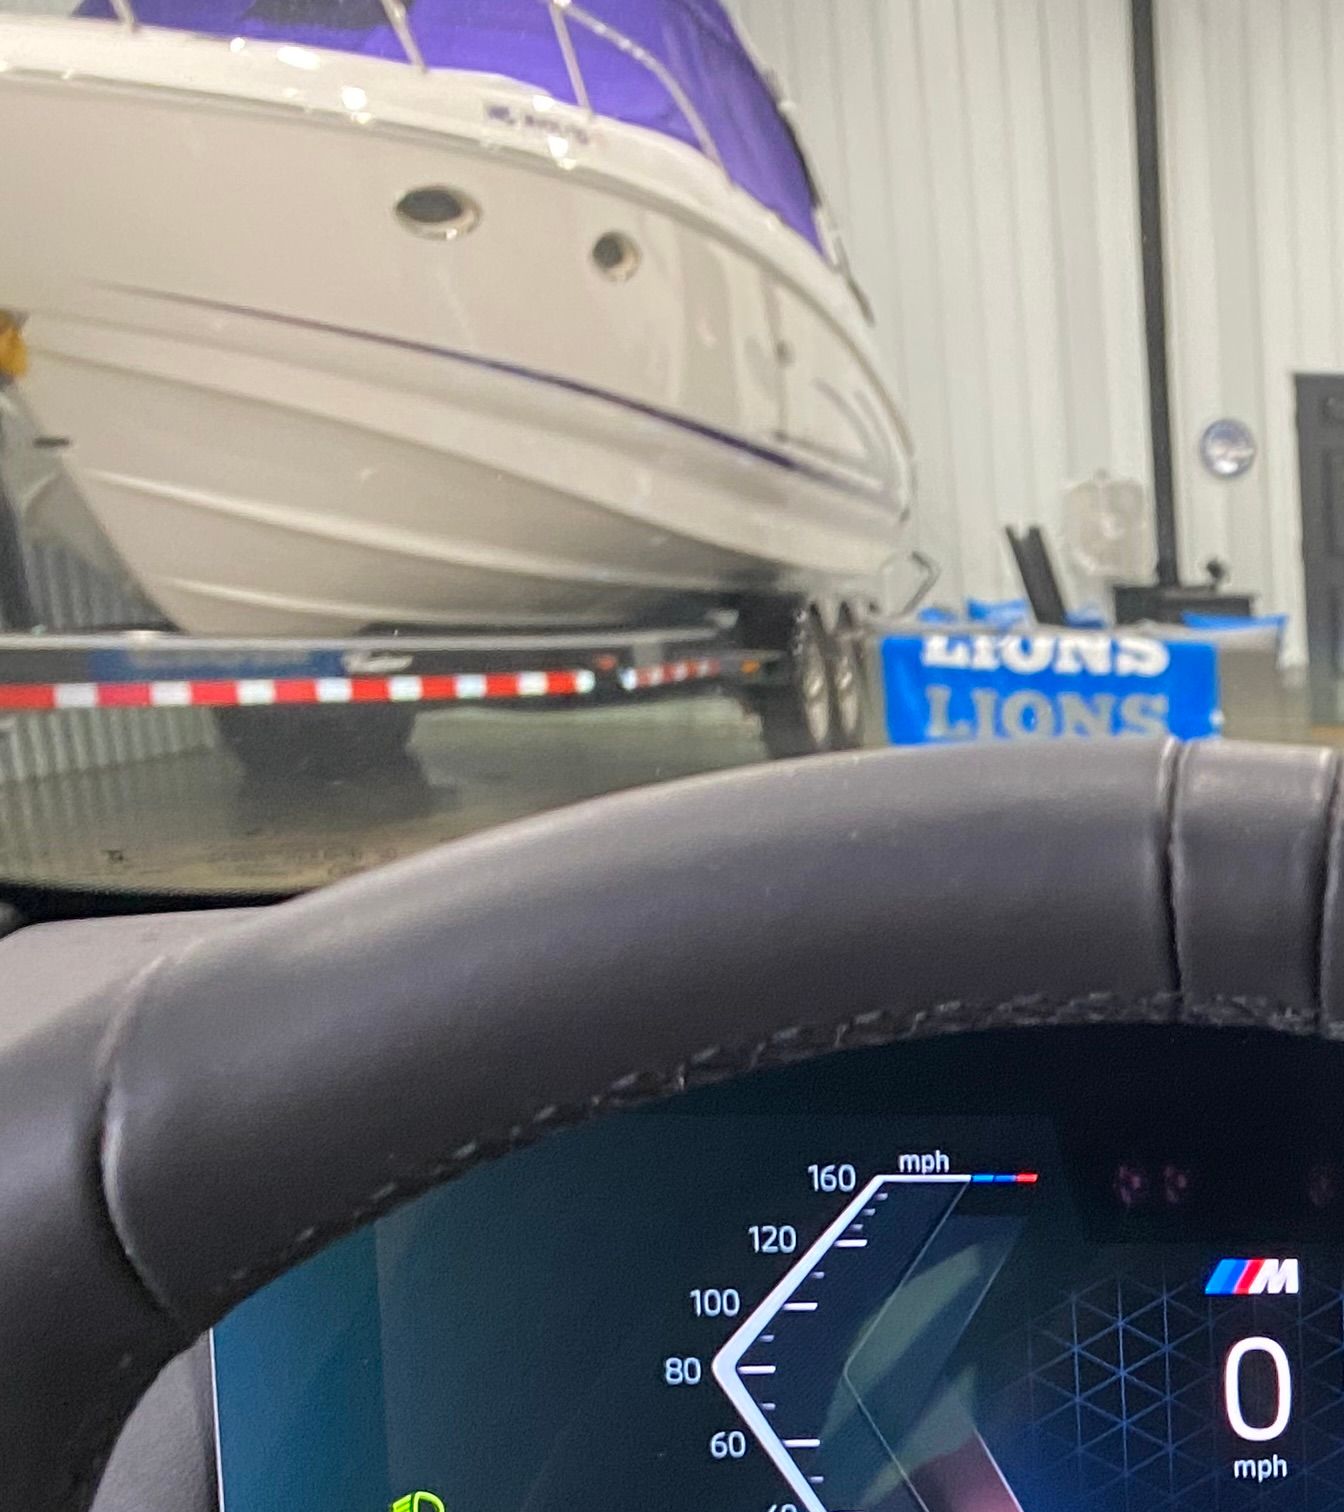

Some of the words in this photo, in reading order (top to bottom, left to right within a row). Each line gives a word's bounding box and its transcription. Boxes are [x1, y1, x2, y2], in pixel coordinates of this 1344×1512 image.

[921, 636, 1171, 677] LIONS
[924, 684, 1169, 738] LIONS
[899, 1150, 950, 1174] mph
[808, 1164, 856, 1193] 160
[748, 1225, 797, 1254] 120
[690, 1289, 740, 1317] 100
[664, 1357, 701, 1386] 80
[1223, 1335, 1292, 1442] 0
[710, 1431, 746, 1459] 60
[1234, 1455, 1288, 1482] mph
